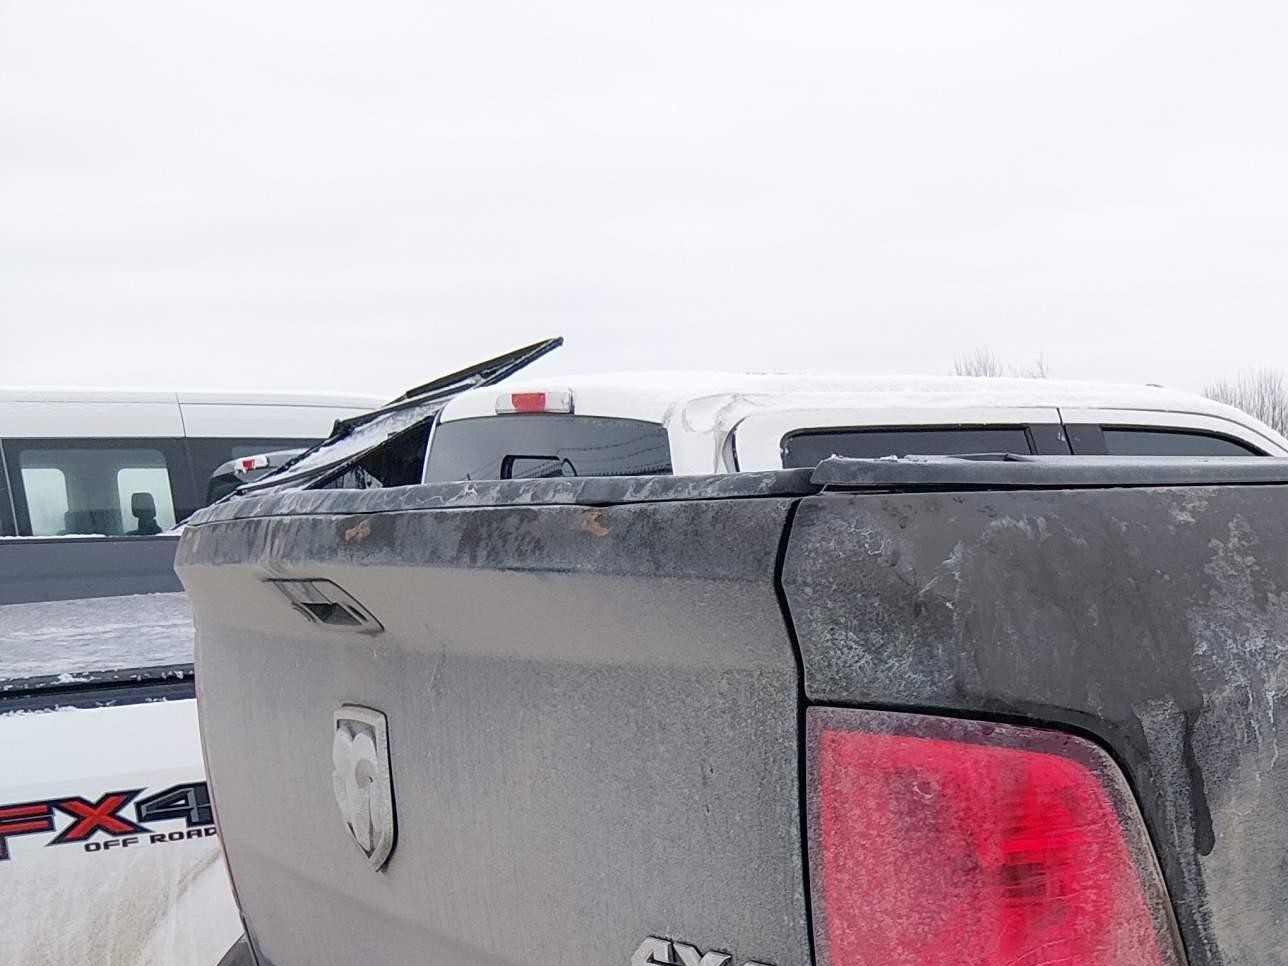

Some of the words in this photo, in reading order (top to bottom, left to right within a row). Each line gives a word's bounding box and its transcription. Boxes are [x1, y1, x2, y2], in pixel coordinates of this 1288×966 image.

[0, 781, 215, 861] FX4
[84, 836, 139, 853] OFF
[150, 826, 218, 845] ROAD
